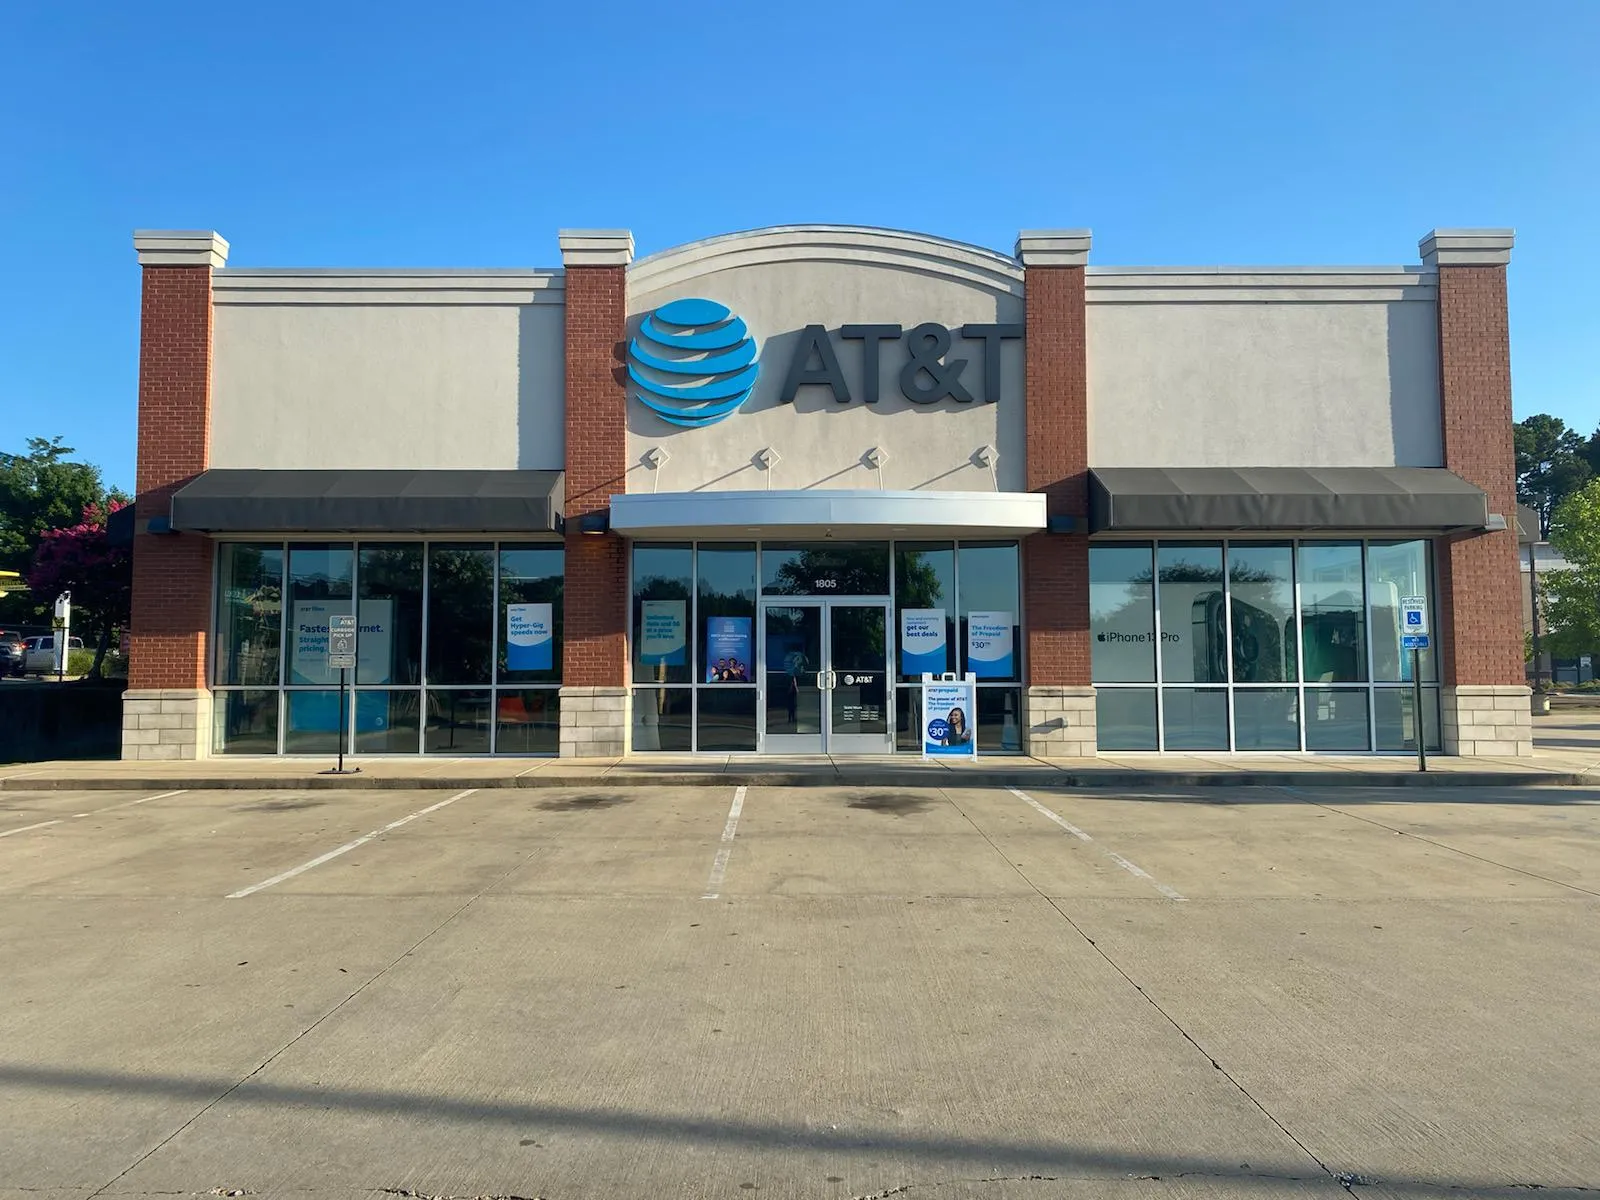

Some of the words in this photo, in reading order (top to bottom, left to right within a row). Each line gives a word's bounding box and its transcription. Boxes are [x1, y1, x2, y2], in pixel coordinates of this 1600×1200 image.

[780, 322, 1022, 404] AT&T
[815, 579, 837, 588] 1805
[300, 624, 330, 632] Fastes
[1106, 632, 1145, 642] iPhone
[1161, 632, 1180, 642] Pro
